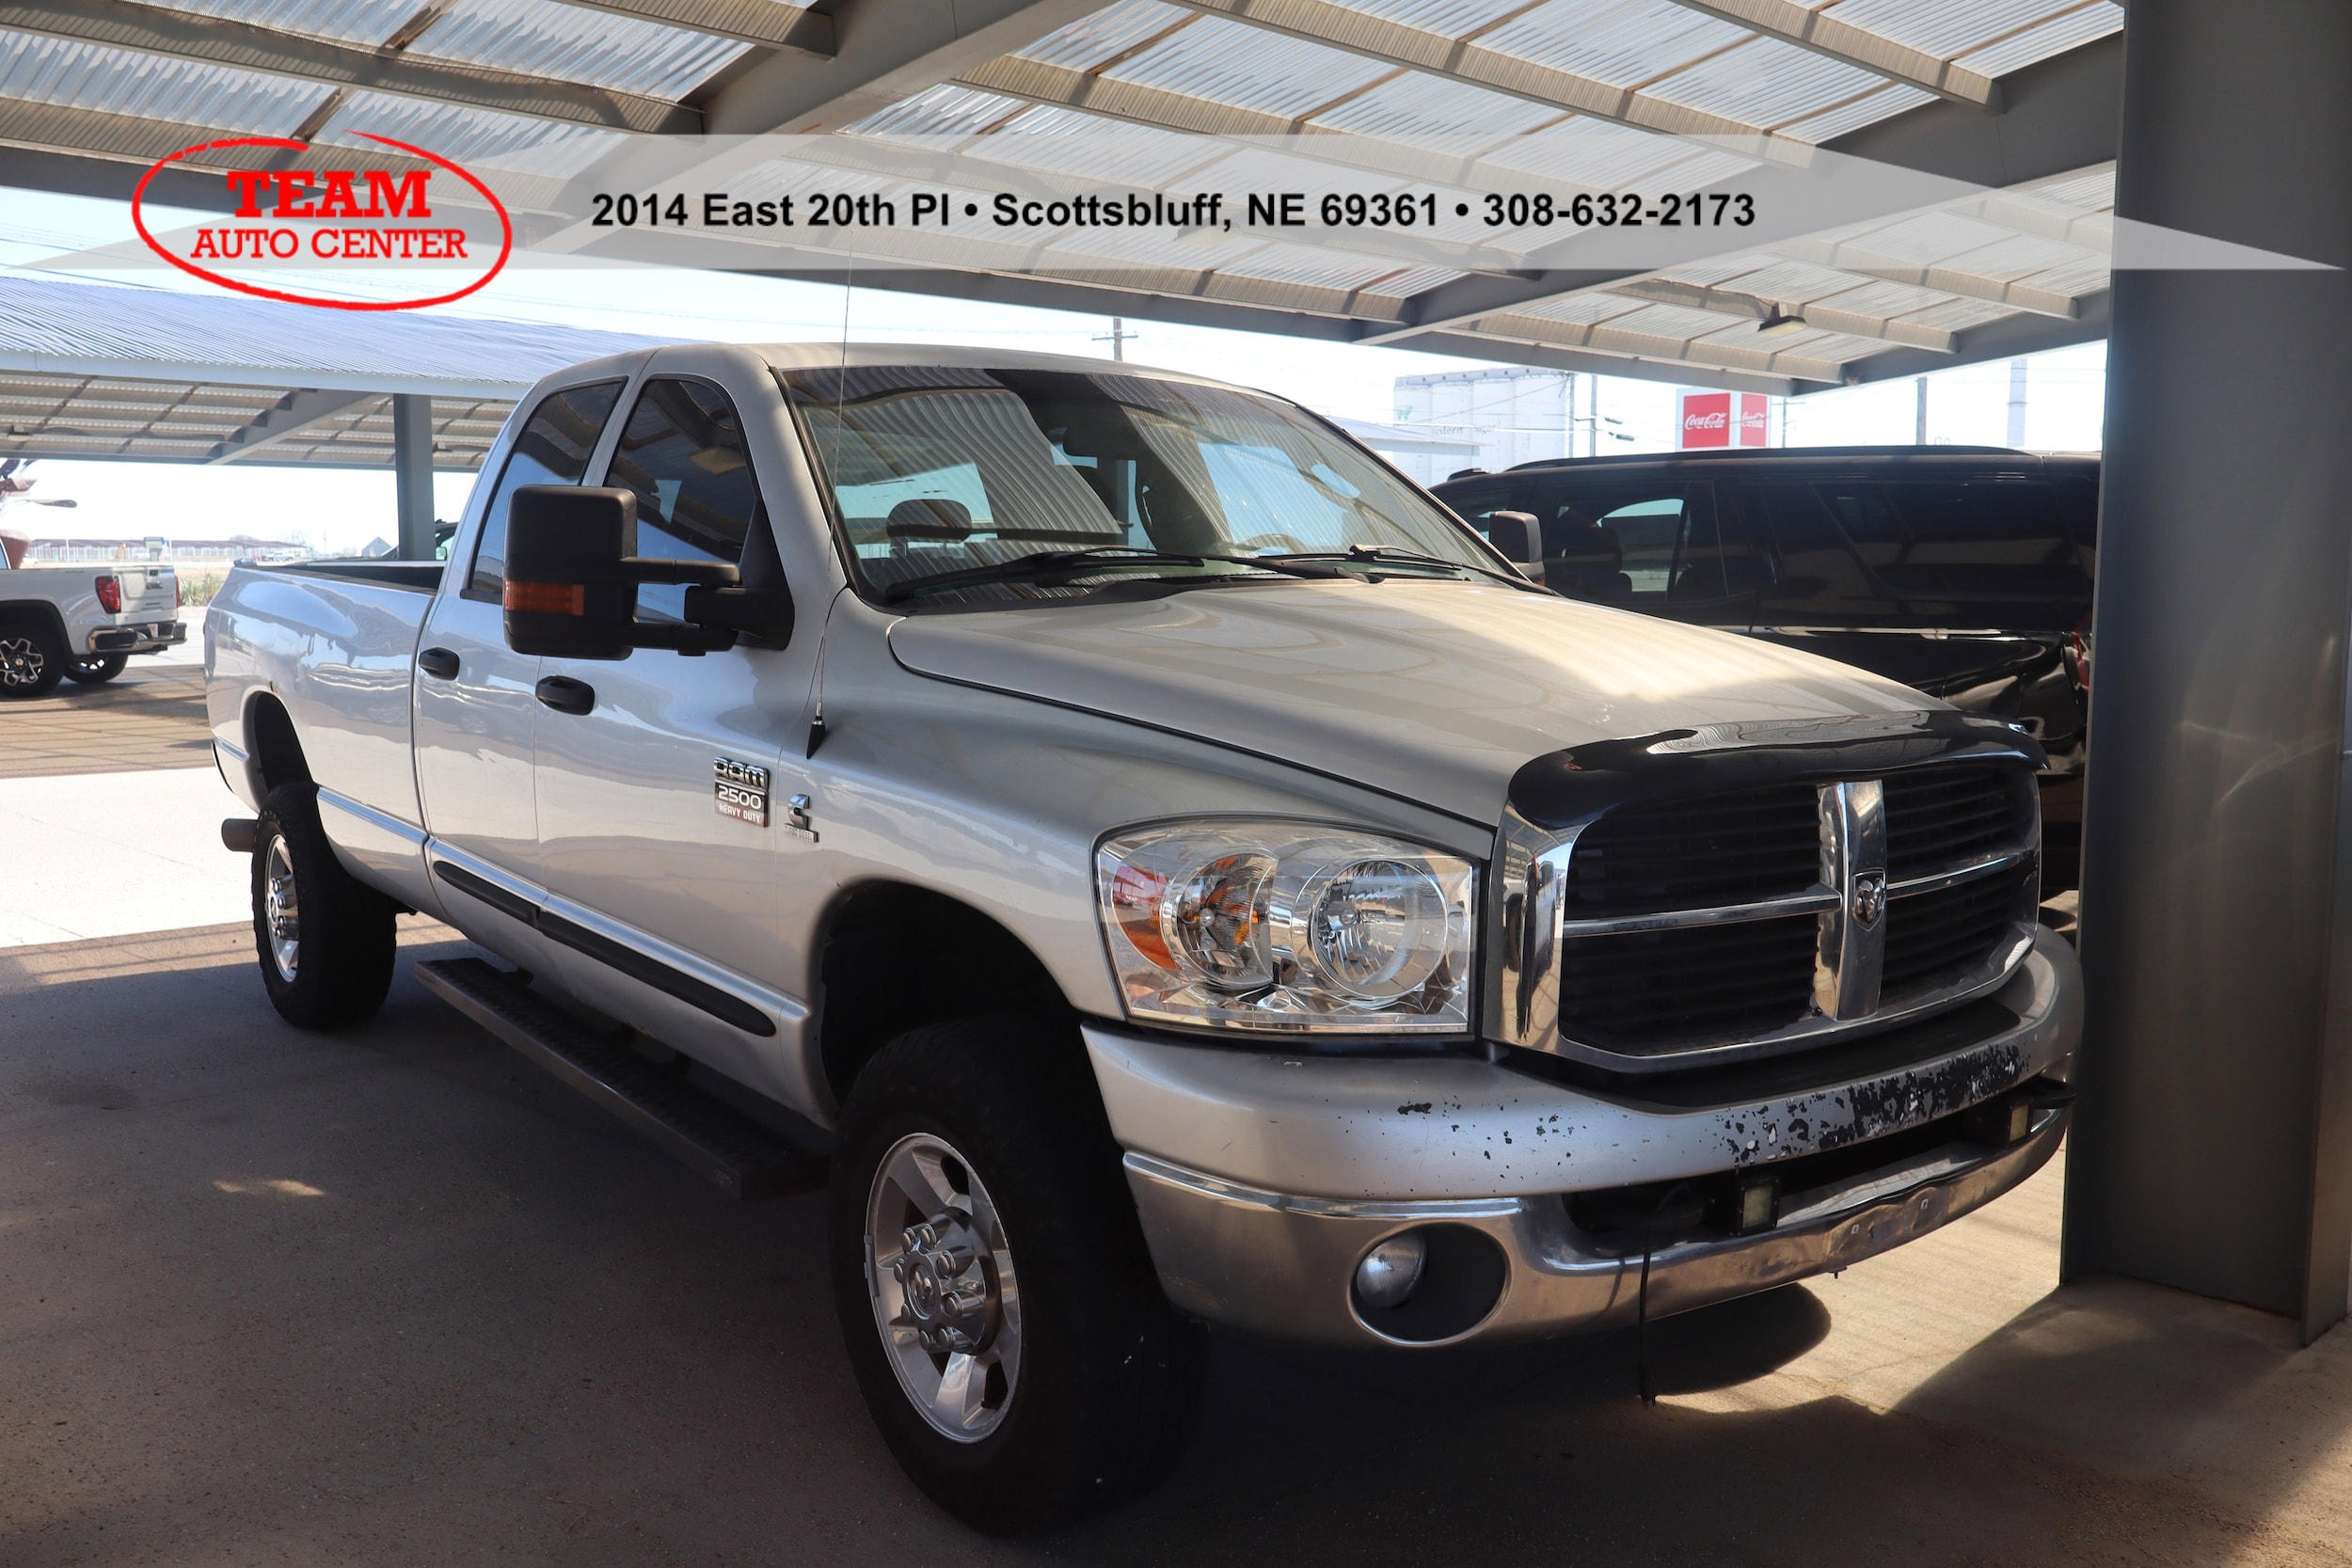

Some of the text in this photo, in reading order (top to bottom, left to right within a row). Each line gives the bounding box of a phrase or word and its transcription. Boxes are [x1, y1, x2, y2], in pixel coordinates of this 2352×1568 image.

[718, 784, 762, 810] 2500
[719, 803, 761, 823] HEAVY DUTY
